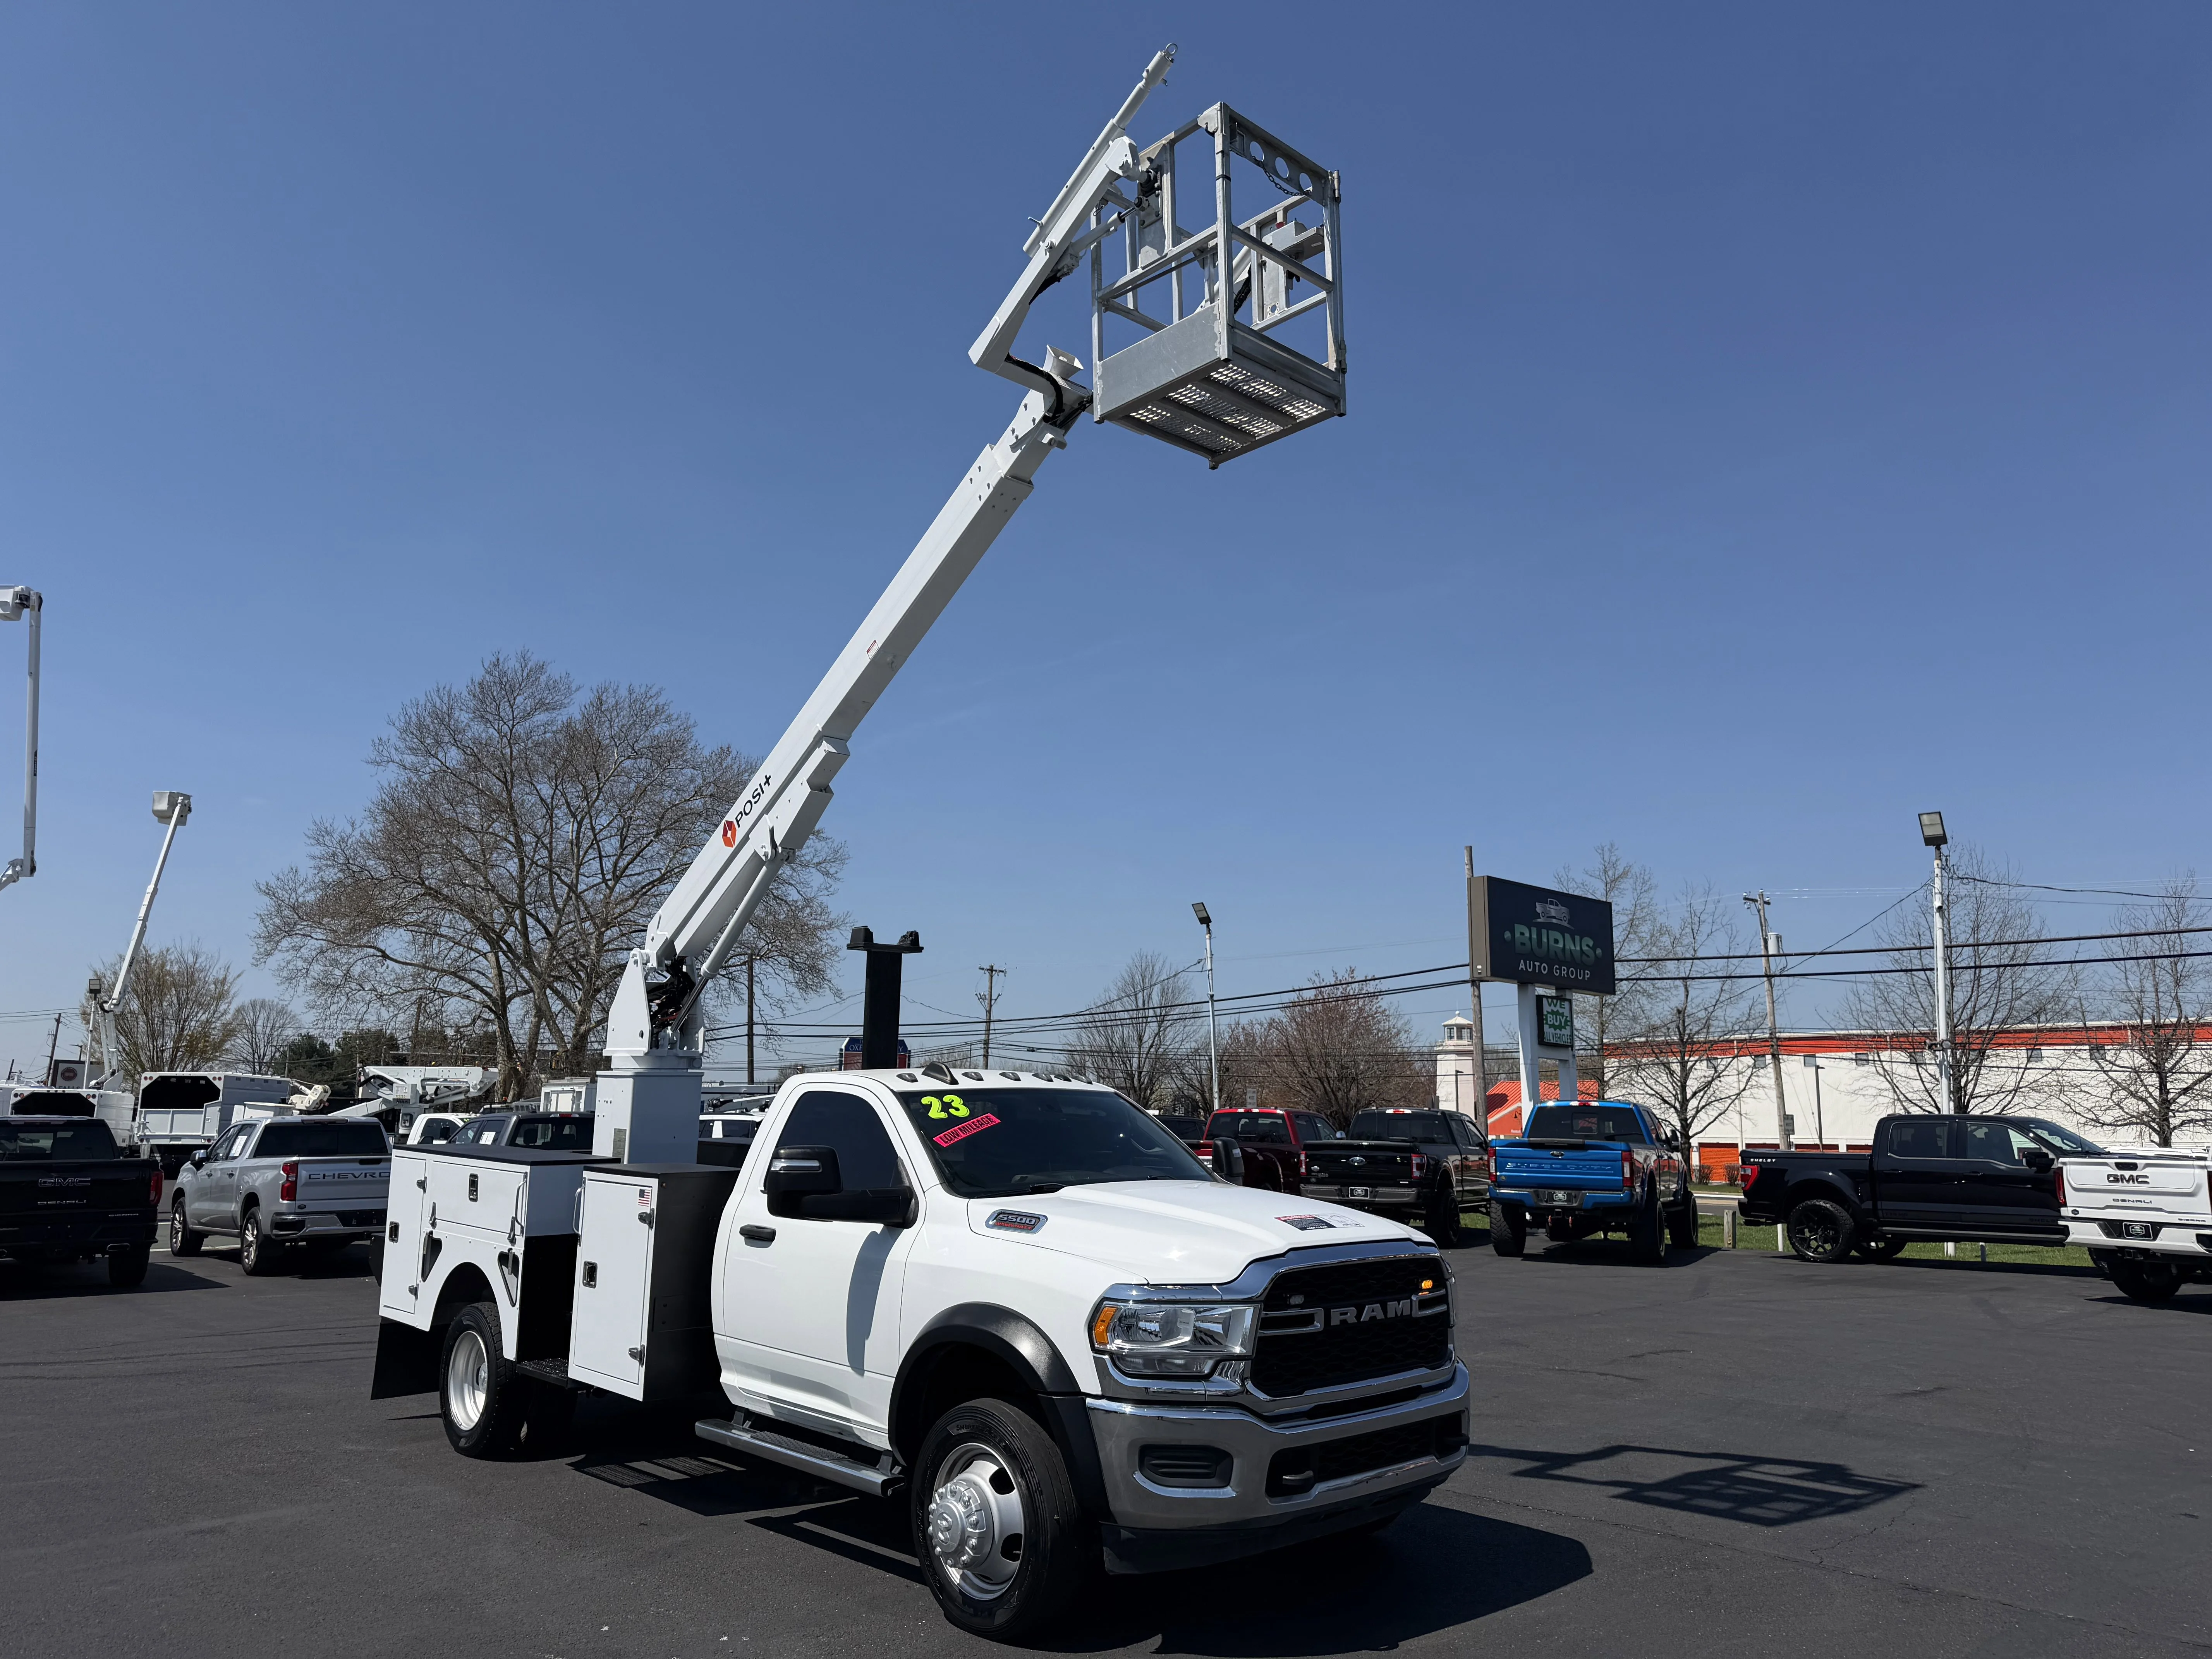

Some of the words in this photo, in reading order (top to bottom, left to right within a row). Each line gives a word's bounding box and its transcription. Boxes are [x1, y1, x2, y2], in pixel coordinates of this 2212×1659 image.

[735, 775, 771, 828] POSI+
[1514, 923, 1595, 966] BURNS
[1519, 959, 1548, 974] AUTO
[1553, 965, 1590, 981] GROUP
[1546, 998, 1565, 1009] WE
[1547, 1014, 1566, 1026] BUY
[1551, 1032, 1571, 1044] VEHICLES
[921, 1095, 970, 1119] 23
[939, 1129, 962, 1144] LOW
[957, 1115, 996, 1135] MILEAGE
[309, 1171, 390, 1180] CHEVRO
[2107, 1173, 2150, 1184] GMC
[39, 1177, 91, 1187] GMC
[999, 1214, 1036, 1225] 5500
[1331, 1299, 1410, 1326] RAM
